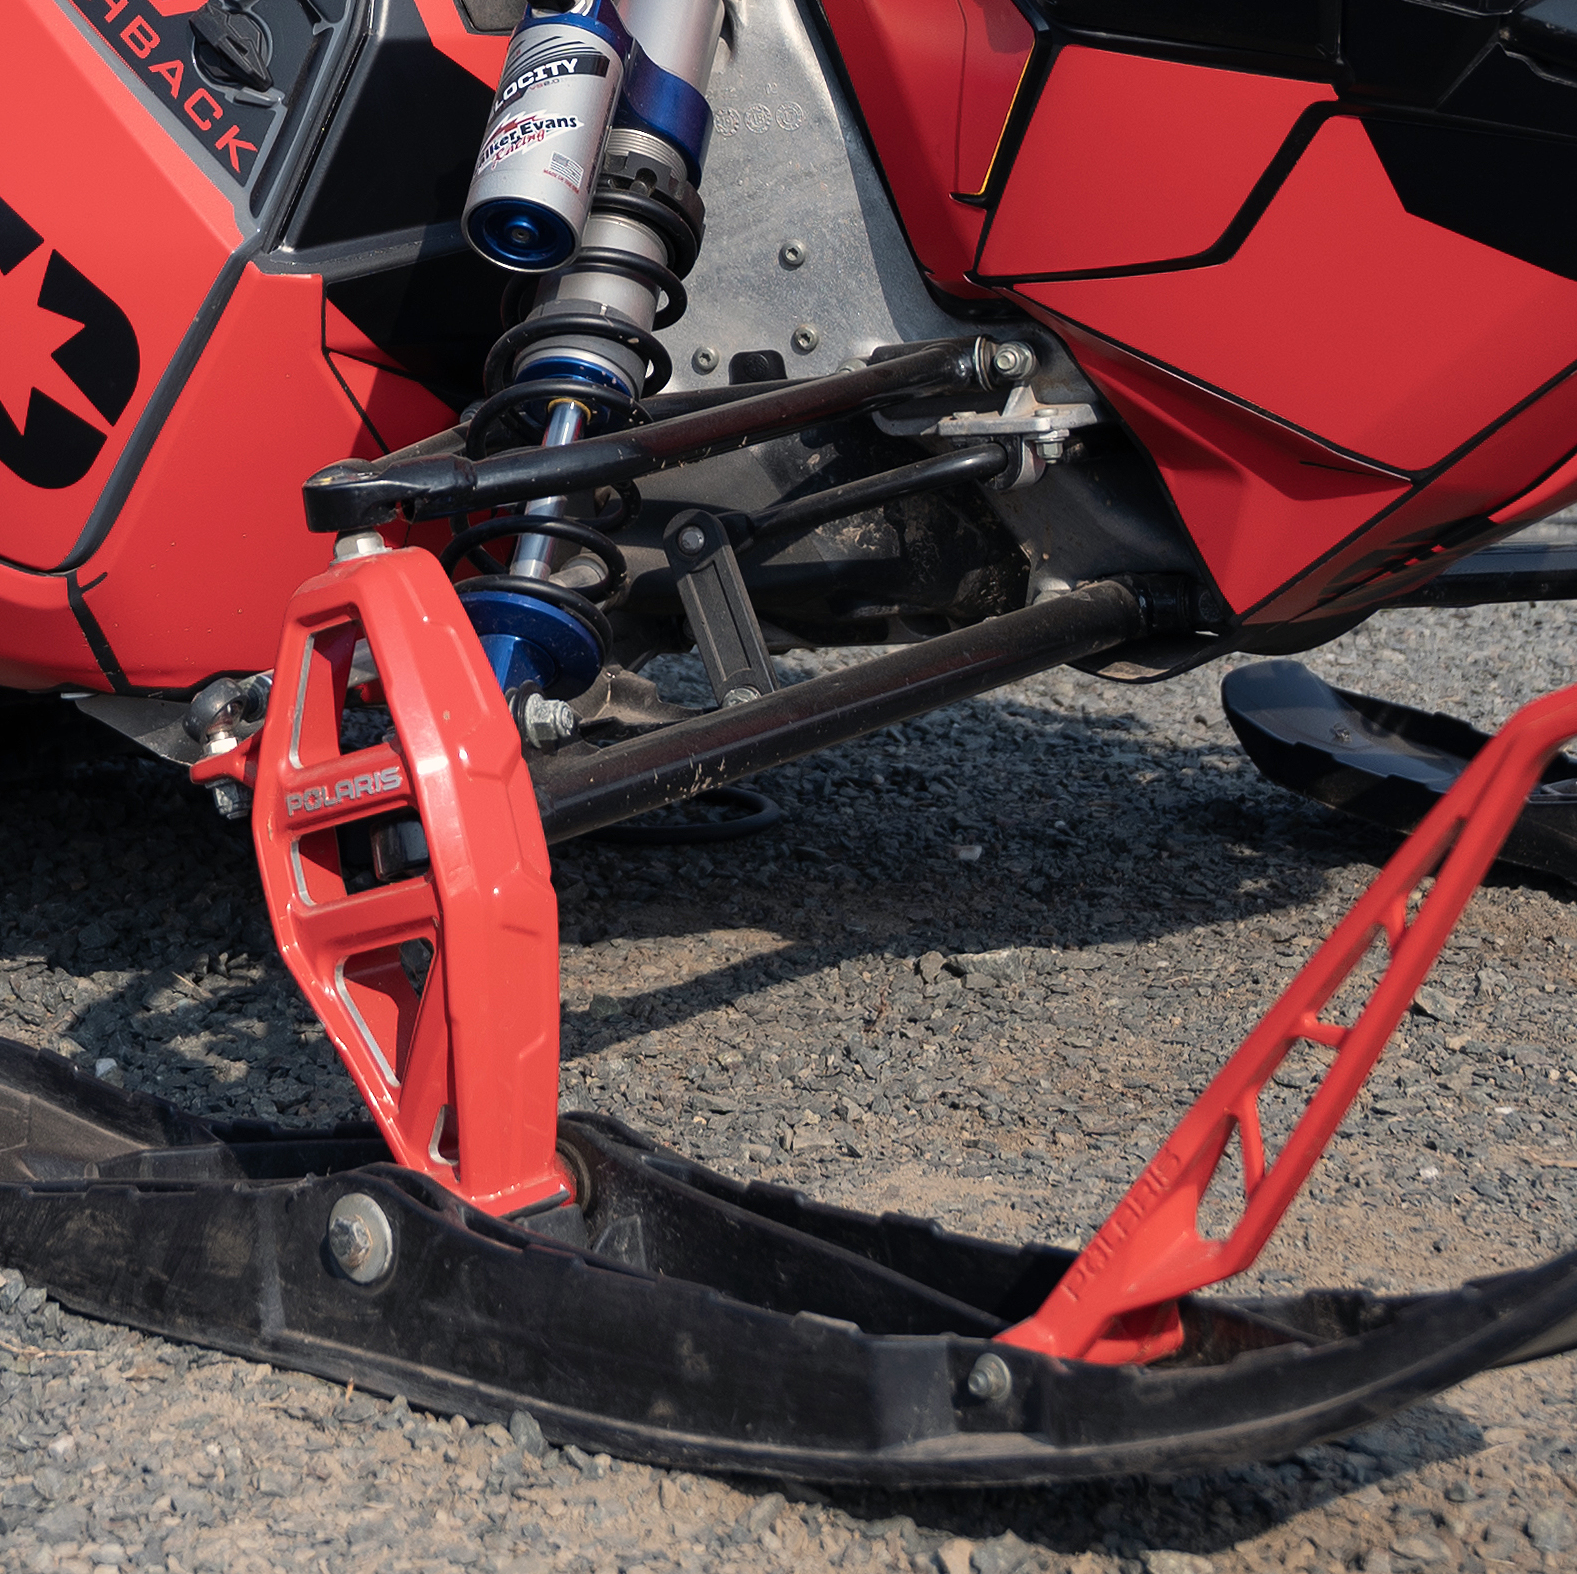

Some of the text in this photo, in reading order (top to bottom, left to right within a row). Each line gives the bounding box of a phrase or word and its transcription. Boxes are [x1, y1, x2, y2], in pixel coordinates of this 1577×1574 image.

[495, 58, 578, 112] LOCITY
[520, 116, 578, 136] Evans
[286, 766, 403, 818] POLARIS
